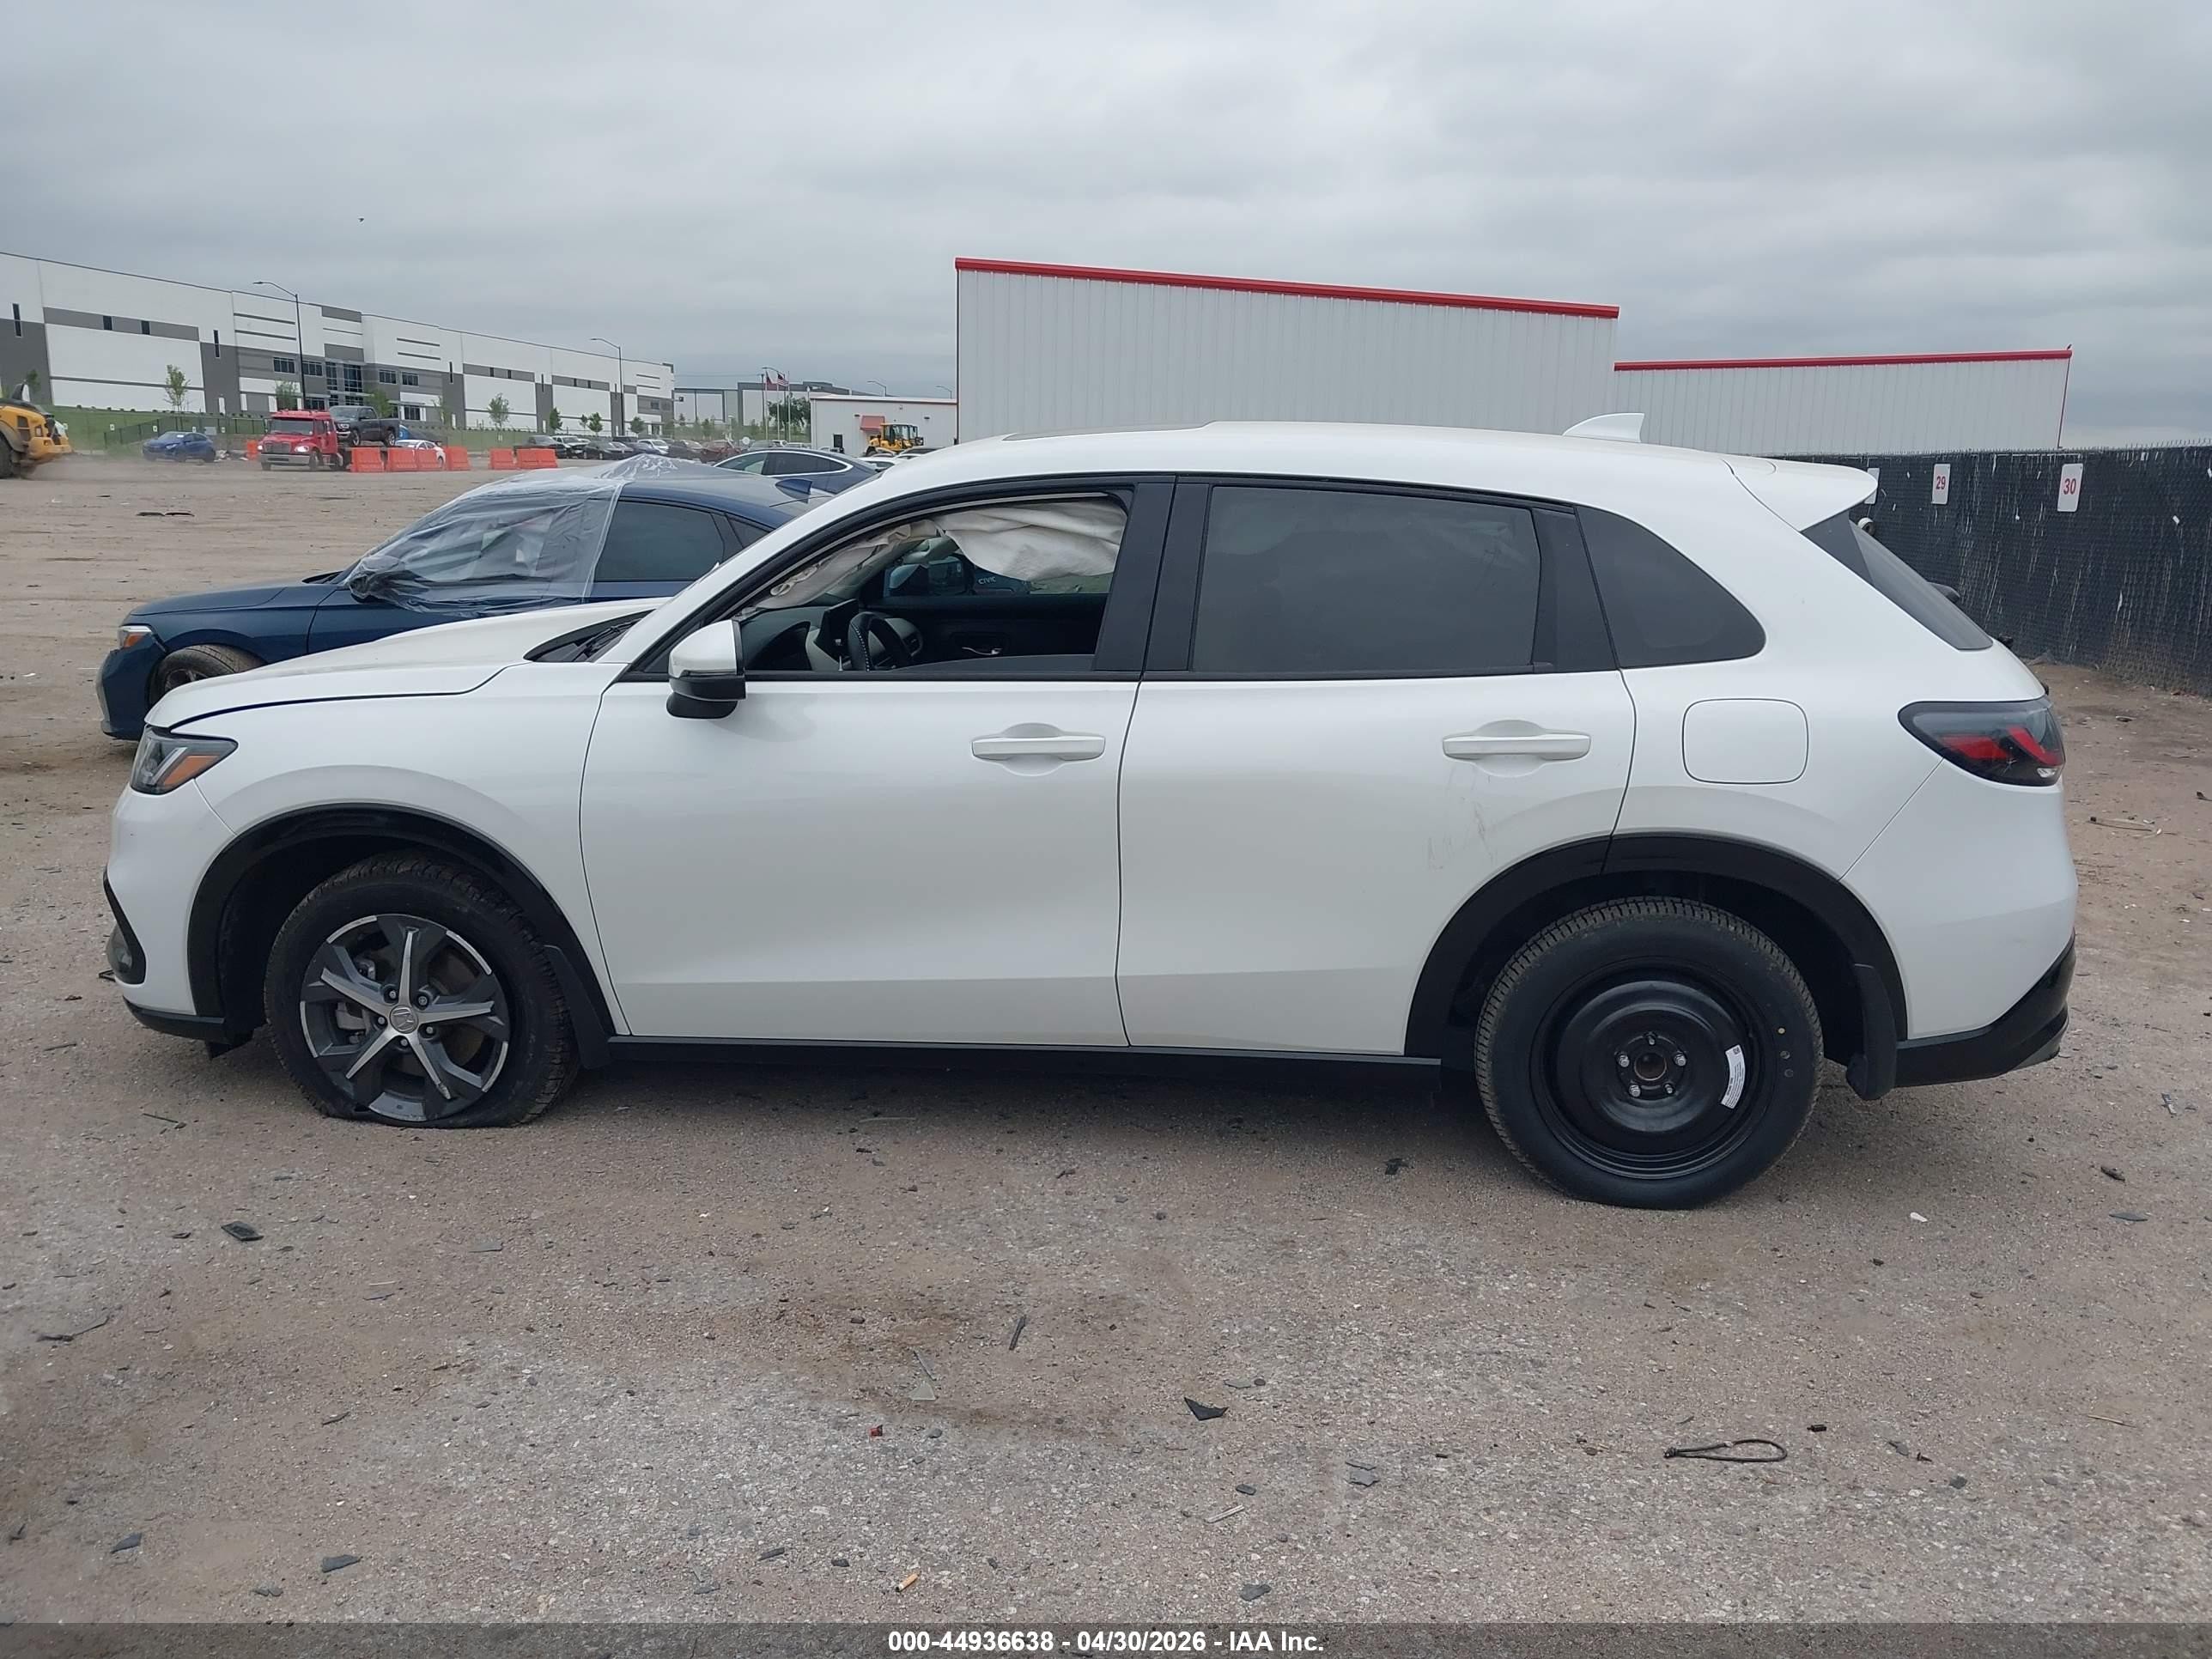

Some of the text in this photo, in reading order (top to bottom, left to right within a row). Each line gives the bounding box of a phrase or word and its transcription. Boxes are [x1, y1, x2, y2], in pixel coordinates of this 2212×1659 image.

[1936, 476, 1947, 489] 29
[2063, 477, 2077, 495] 30
[978, 576, 997, 585] CIVIC
